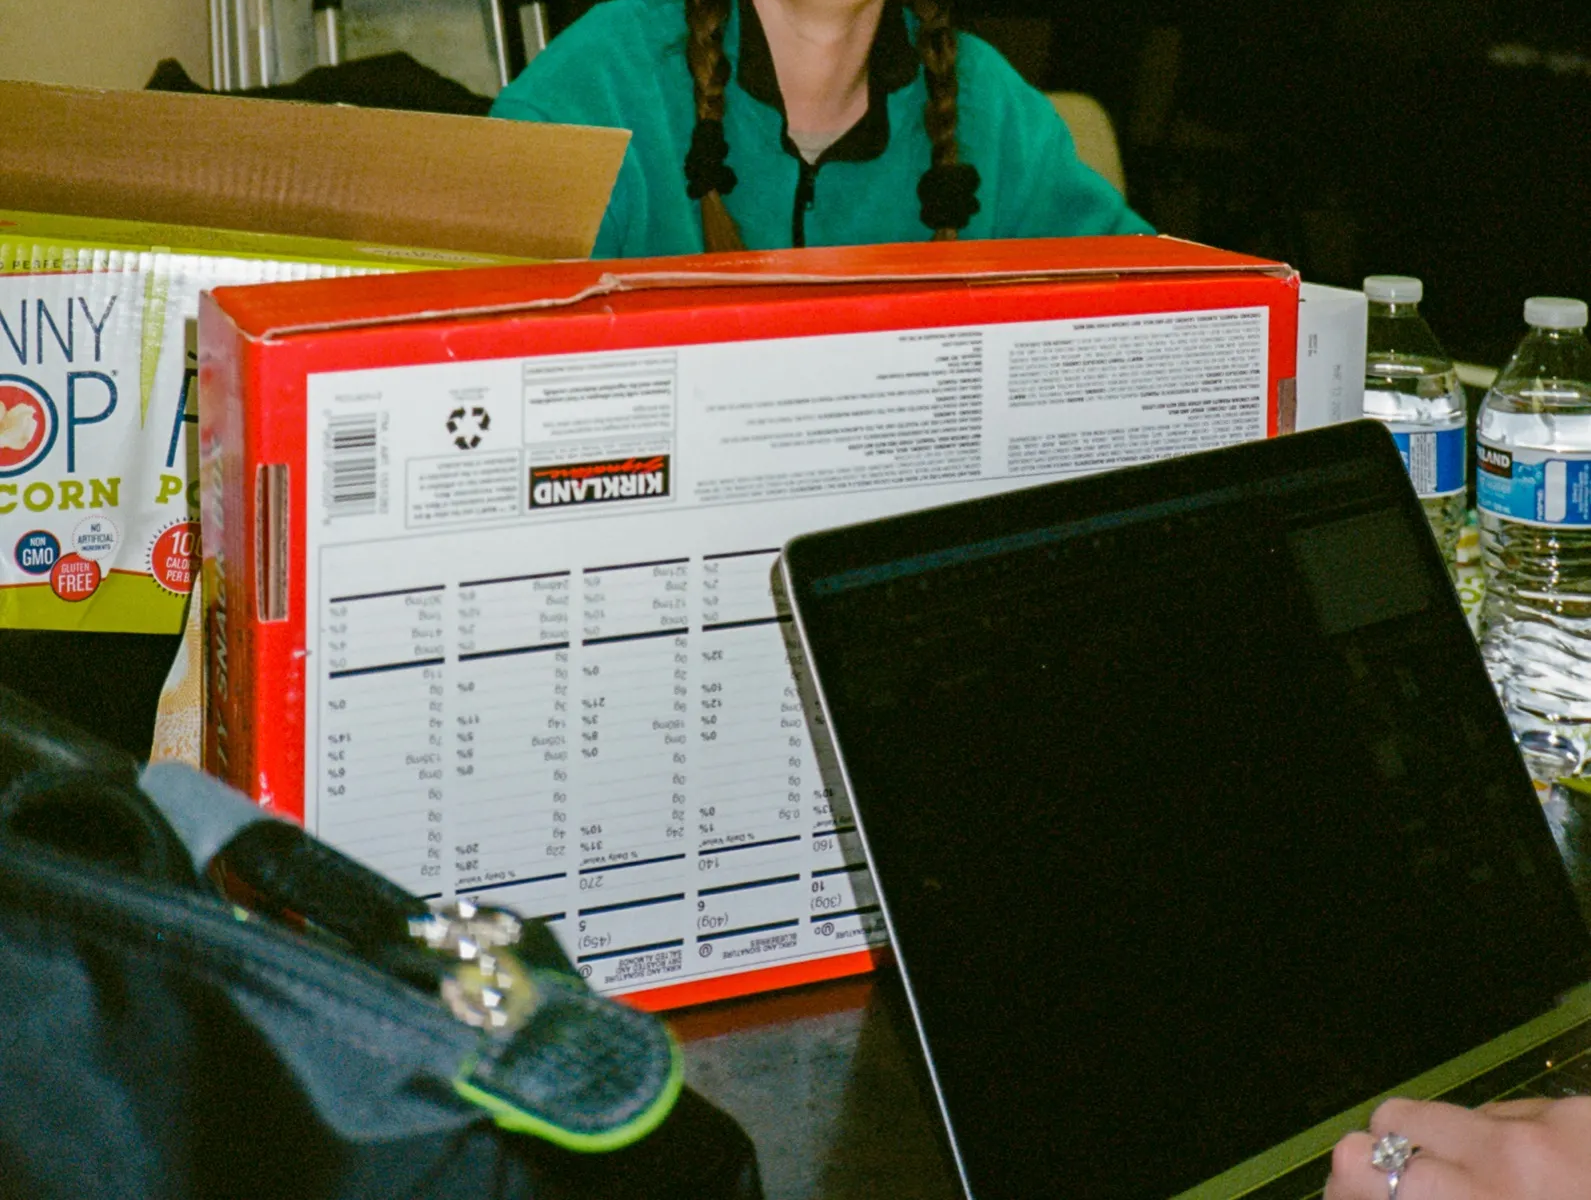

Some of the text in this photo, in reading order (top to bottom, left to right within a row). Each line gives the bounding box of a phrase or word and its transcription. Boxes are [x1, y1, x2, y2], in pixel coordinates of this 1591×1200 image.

[532, 471, 664, 504] KIRKLAND
[91, 523, 101, 533] NO
[30, 536, 46, 547] NON
[78, 533, 114, 544] ARTIFICIAL
[22, 547, 54, 566] GMO
[61, 562, 90, 573] GLUTEN
[58, 573, 94, 593] FREE
[582, 665, 600, 676] 0%
[328, 699, 347, 711] 0%
[581, 696, 606, 710] 21%
[700, 698, 723, 710] 12%
[429, 717, 443, 728] 4g
[456, 714, 480, 727] 11%
[547, 717, 566, 729] 14g
[700, 714, 717, 726] 0%
[327, 732, 352, 745] 14%
[700, 730, 717, 742] 0%
[788, 736, 801, 748] 0g
[581, 746, 599, 758] 0%
[672, 752, 686, 764] 0g
[788, 756, 801, 768] 0g
[788, 774, 801, 787] 0g
[327, 784, 346, 797] 0%
[553, 791, 567, 803] 0g
[788, 791, 801, 803] 0g
[672, 792, 686, 805] 0g
[672, 808, 685, 824] 2g
[698, 806, 716, 819] 0%
[778, 808, 800, 821] 0.5g
[552, 826, 566, 840] 4g
[580, 824, 603, 837] 10%
[665, 825, 685, 841] 24g
[698, 822, 715, 836] 1%
[726, 833, 745, 842] Daily
[454, 842, 479, 856] 20%
[546, 843, 566, 858] 22g
[579, 840, 603, 856] 31%
[812, 839, 834, 853] 160
[609, 852, 629, 862] Daily
[420, 864, 441, 877] 22g
[454, 858, 479, 872] 28%
[697, 856, 720, 872] 140
[484, 872, 505, 881] Daily
[579, 875, 604, 891] 270
[812, 881, 825, 893] 10
[696, 899, 707, 913] 6
[811, 893, 842, 911] (30g)
[578, 919, 588, 933] 5
[696, 912, 728, 930] (40g)
[577, 932, 612, 950] (45g)
[750, 933, 797, 947] BLUEBERRIES
[722, 940, 797, 959] KIRKLAND SIGNATURE
[619, 950, 682, 968] SALTED ALMONDS
[615, 957, 682, 975] DRY ROASTED AND
[604, 965, 682, 984] KIRKLAND SIGNATURE
